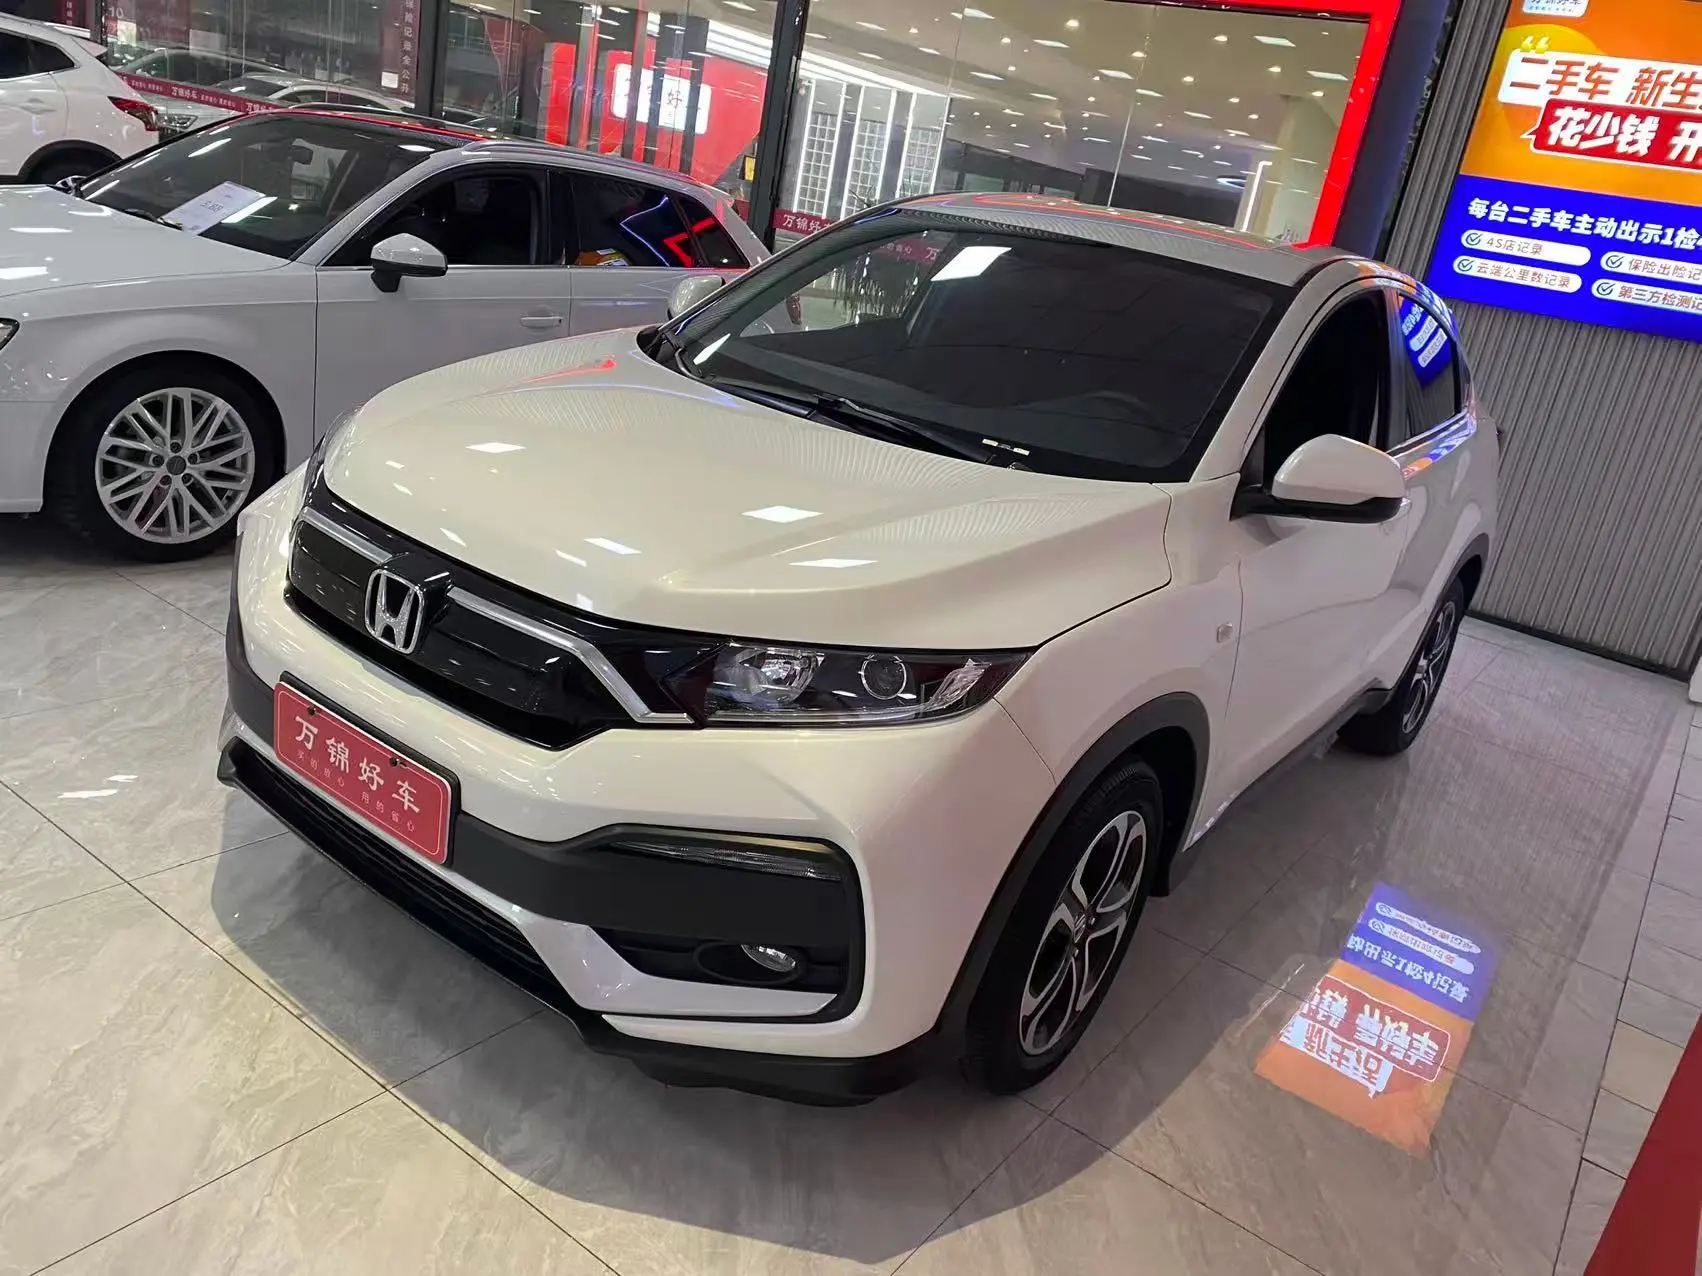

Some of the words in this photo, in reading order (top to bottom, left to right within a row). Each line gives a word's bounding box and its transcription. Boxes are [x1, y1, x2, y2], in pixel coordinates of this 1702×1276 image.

[1510, 57, 1620, 100] 二手车
[1626, 67, 1702, 110] 新生
[1548, 106, 1660, 157] 花少钱
[1468, 198, 1702, 250] 每台二手车主动出示1检
[1487, 238, 1544, 256] 4S店记录
[1476, 261, 1571, 288] 云端公里数记录
[295, 715, 420, 813] 万锦好车
